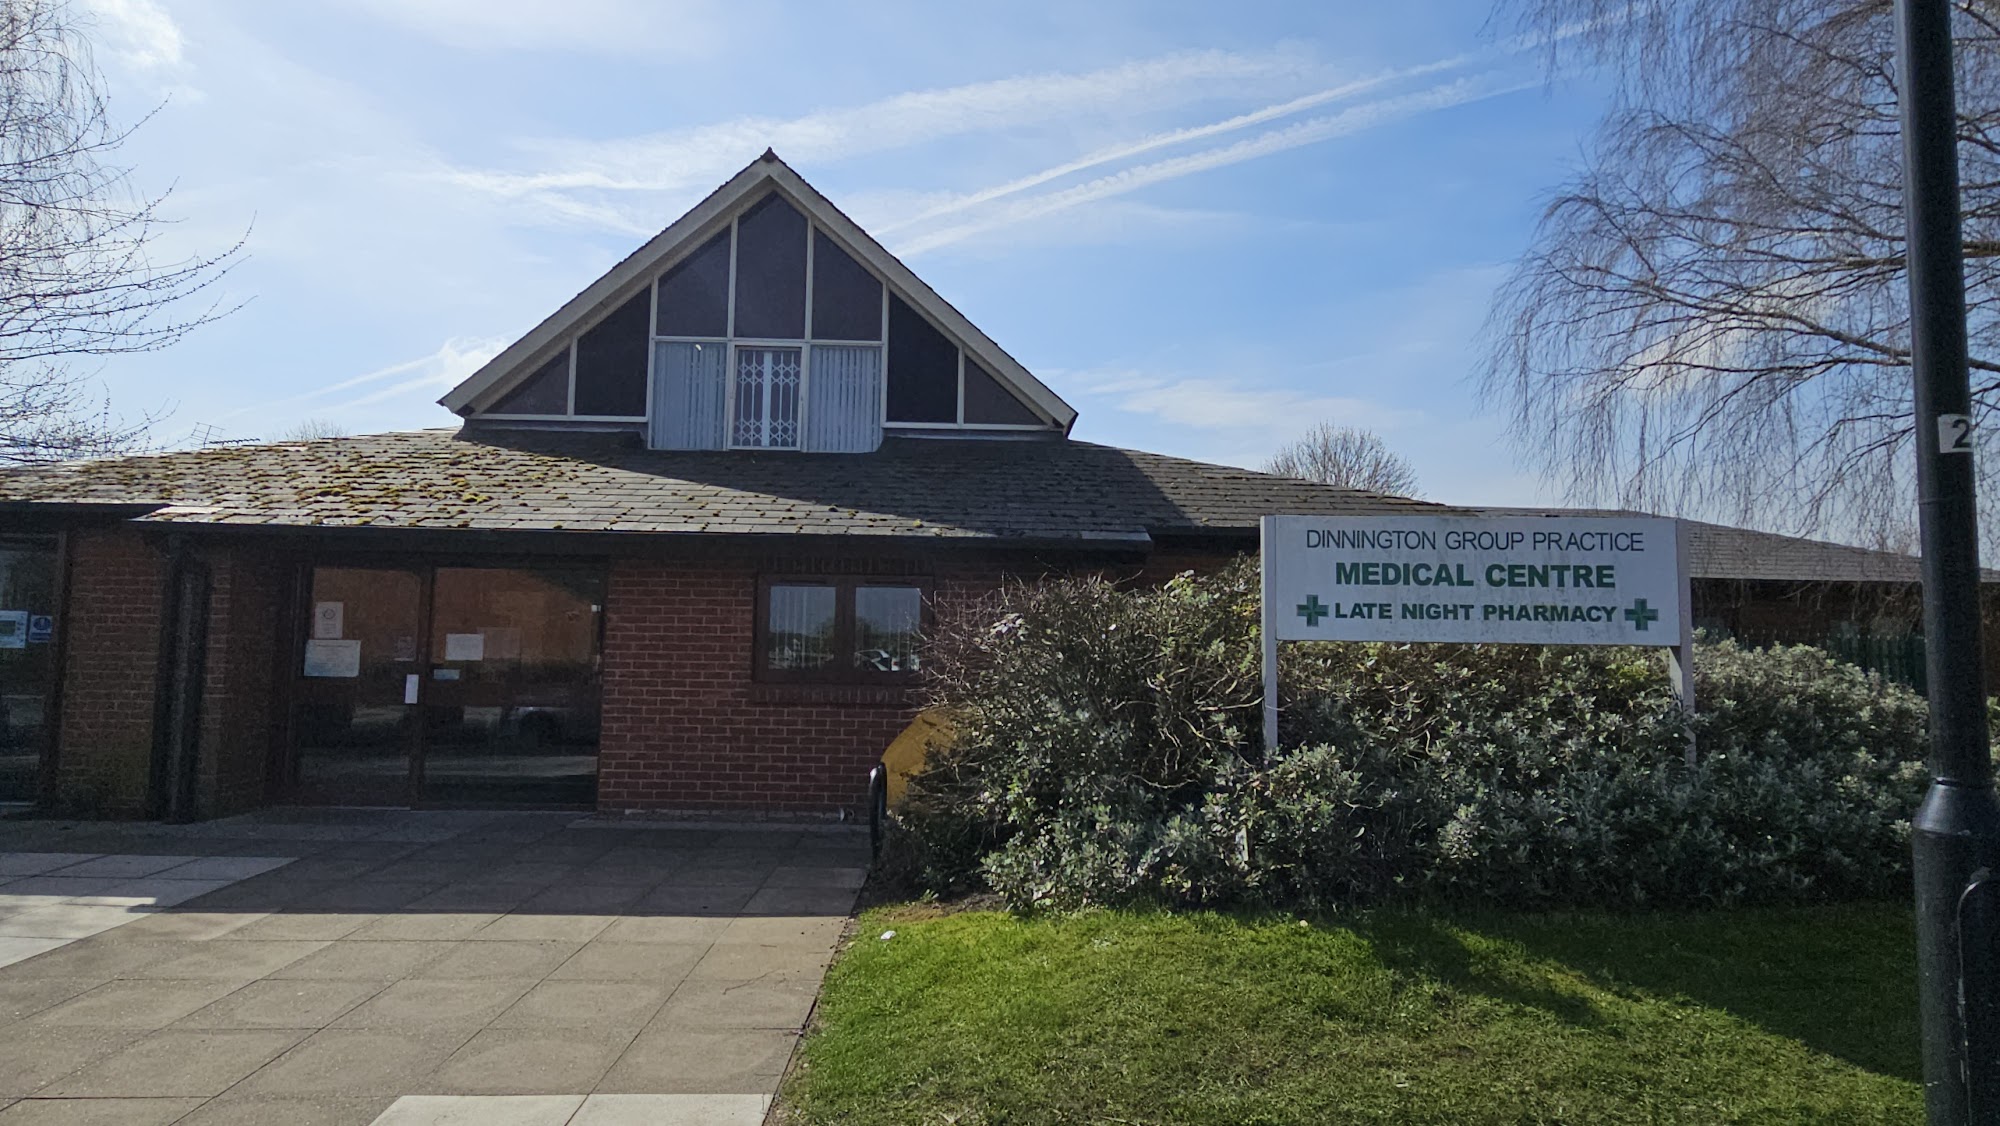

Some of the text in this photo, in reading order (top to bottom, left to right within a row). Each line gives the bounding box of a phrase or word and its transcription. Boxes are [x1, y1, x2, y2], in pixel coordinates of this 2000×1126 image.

[1306, 529, 1645, 551] DINNINGTON GROUP PRACTICE
[1335, 562, 1616, 588] MEDICAL CENTRE
[1335, 603, 1617, 622] LATE NIGHT PHARMACY
